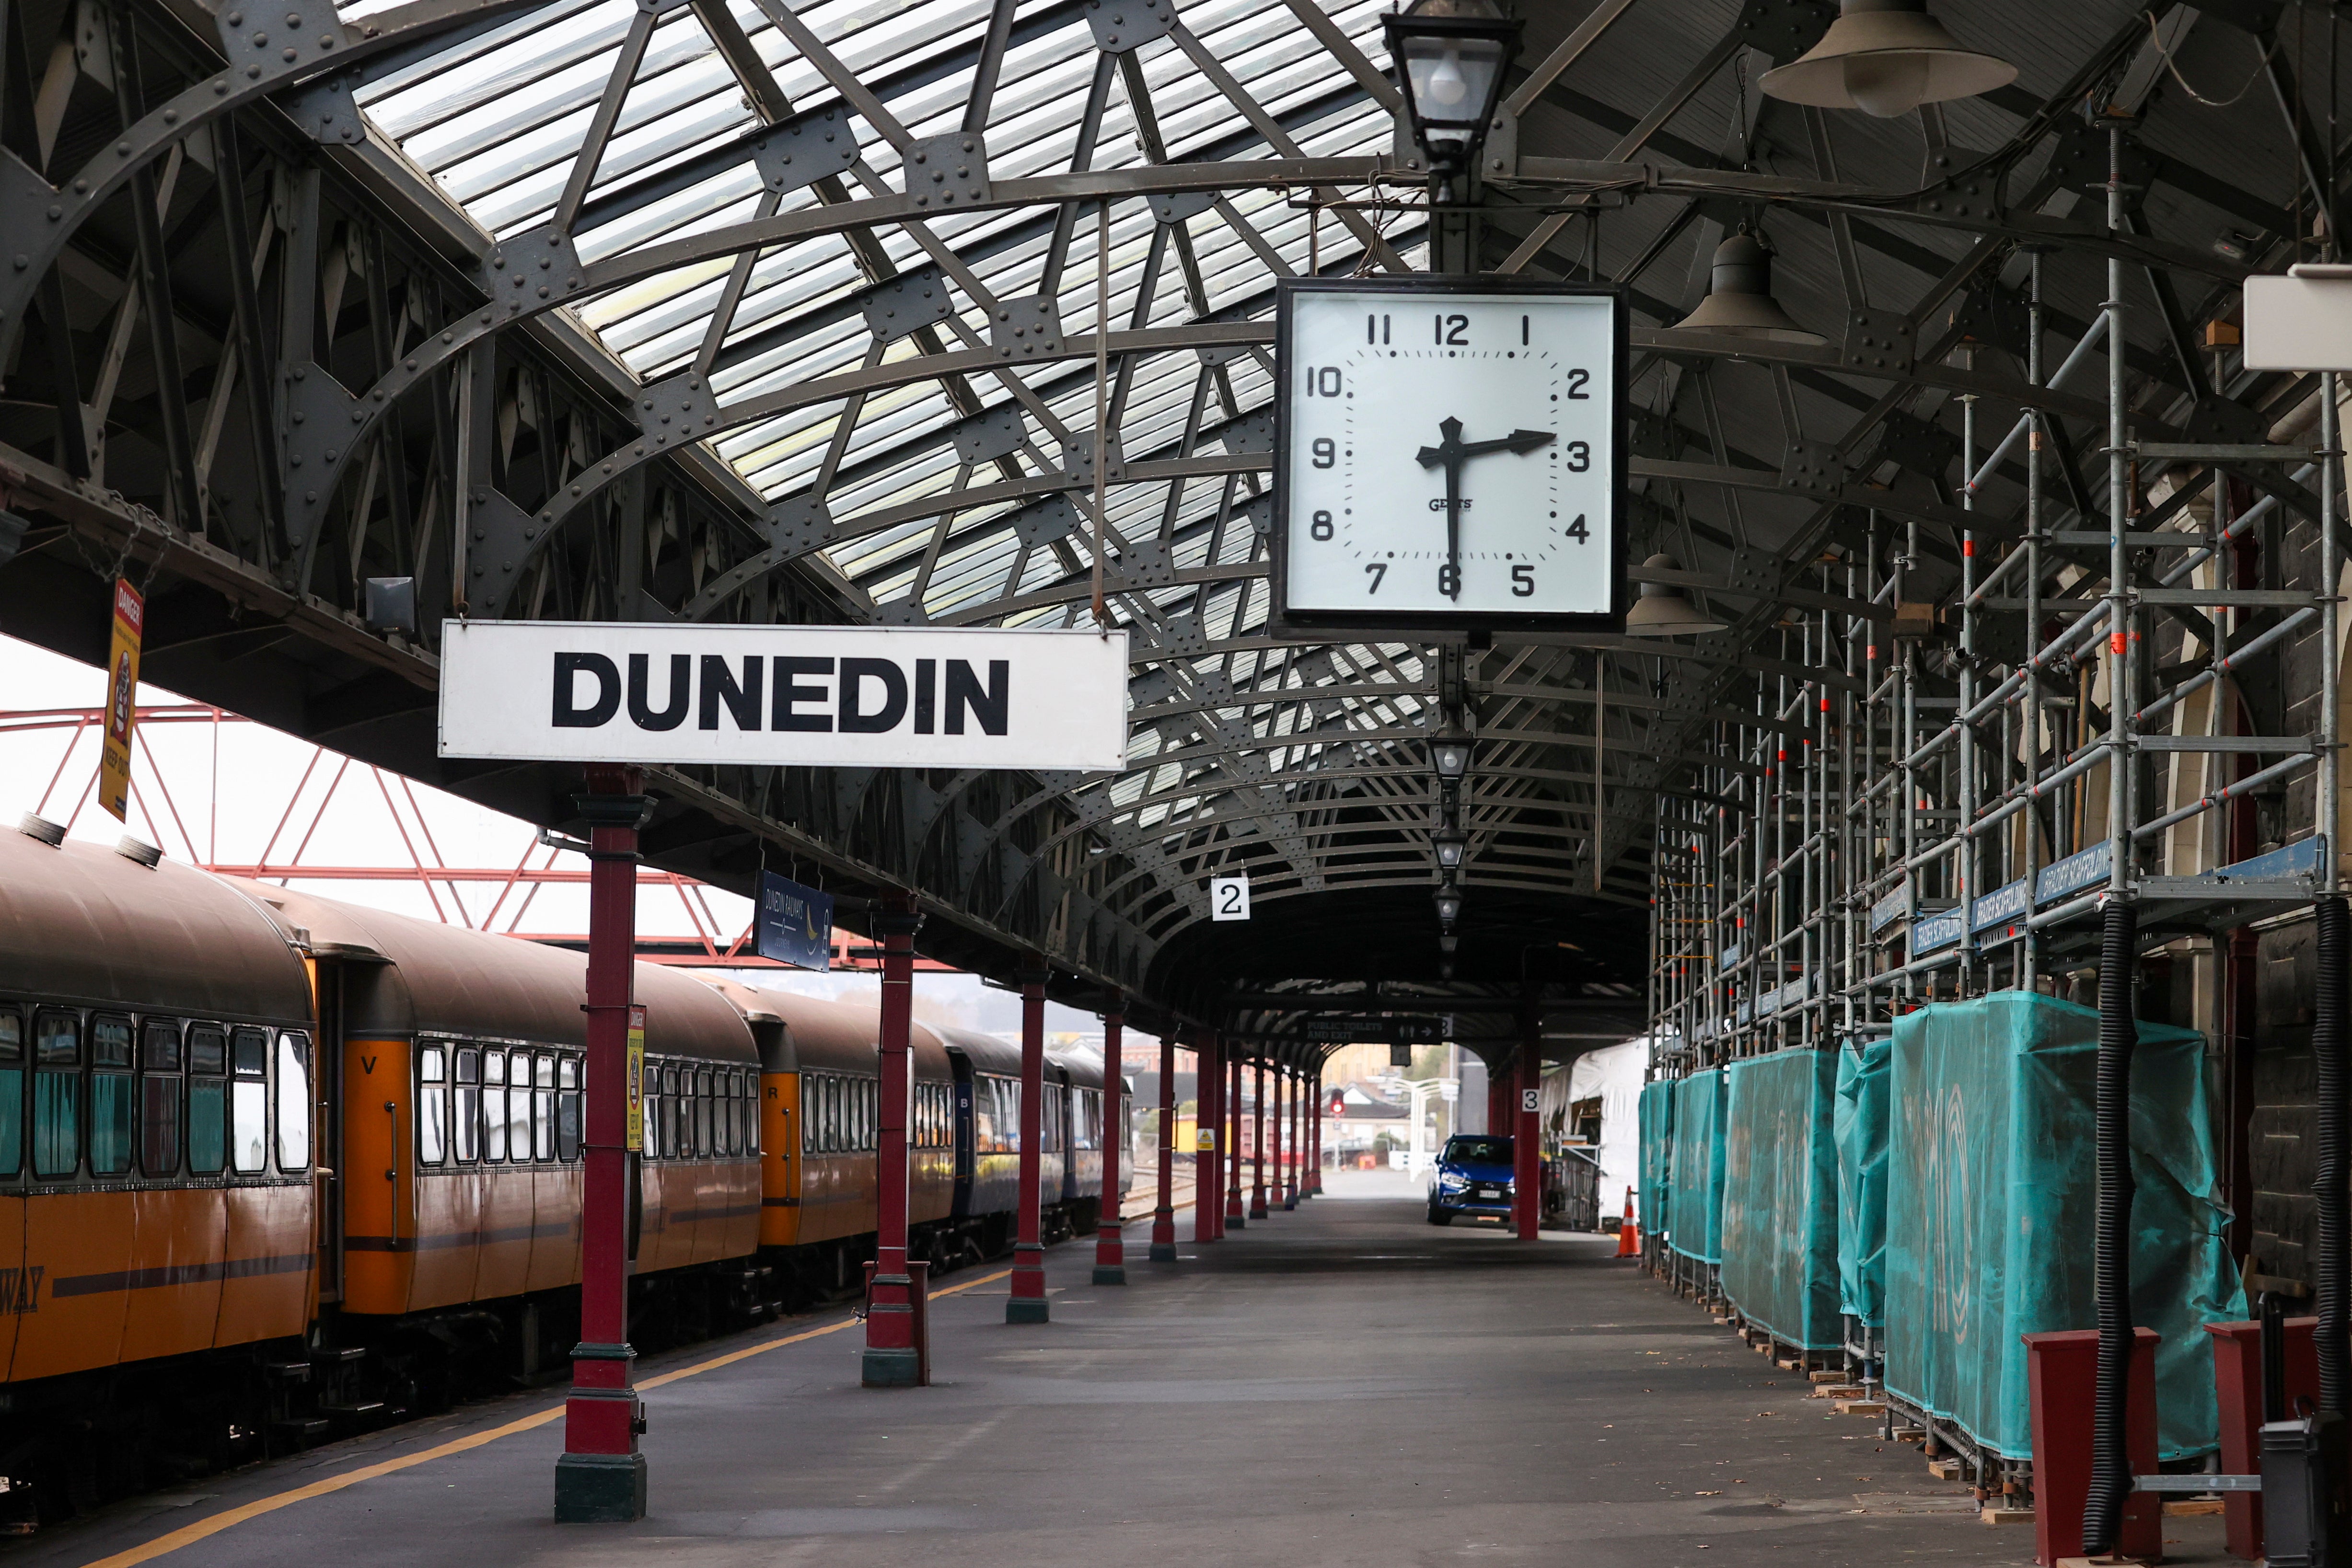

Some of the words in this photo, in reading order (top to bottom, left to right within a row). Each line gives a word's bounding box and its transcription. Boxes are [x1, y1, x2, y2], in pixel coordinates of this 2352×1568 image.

[1368, 314, 1390, 345] 11
[1436, 315, 1469, 345] 12
[1522, 315, 1529, 346] 1
[1308, 367, 1341, 397] 10
[1568, 369, 1589, 399] 2
[1313, 438, 1334, 468] 9
[1567, 441, 1589, 472] 3
[1429, 499, 1472, 511] GETS
[1311, 511, 1333, 541] 8
[1565, 514, 1589, 544] 4
[1366, 564, 1387, 594] 7
[1438, 565, 1461, 595] 6
[1512, 565, 1534, 597] 5
[118, 587, 140, 626] DANGER
[552, 652, 1008, 735] DUNEDIN
[2043, 863, 2069, 898] BRAZIER
[766, 888, 785, 913] DUNEDIN
[786, 895, 803, 920] RAILWAYS
[1221, 885, 1241, 913] 2
[1977, 896, 1995, 927] BRAZIER
[1995, 882, 2027, 918] SCAFFOLDING
[1918, 922, 1933, 948] BRAZIER
[1308, 1022, 1341, 1030] PUBLIC
[1342, 1022, 1382, 1031] TOILETS
[361, 1057, 376, 1074] V
[769, 1088, 778, 1098] R
[961, 1098, 968, 1108] B
[1525, 1091, 1537, 1109] 3
